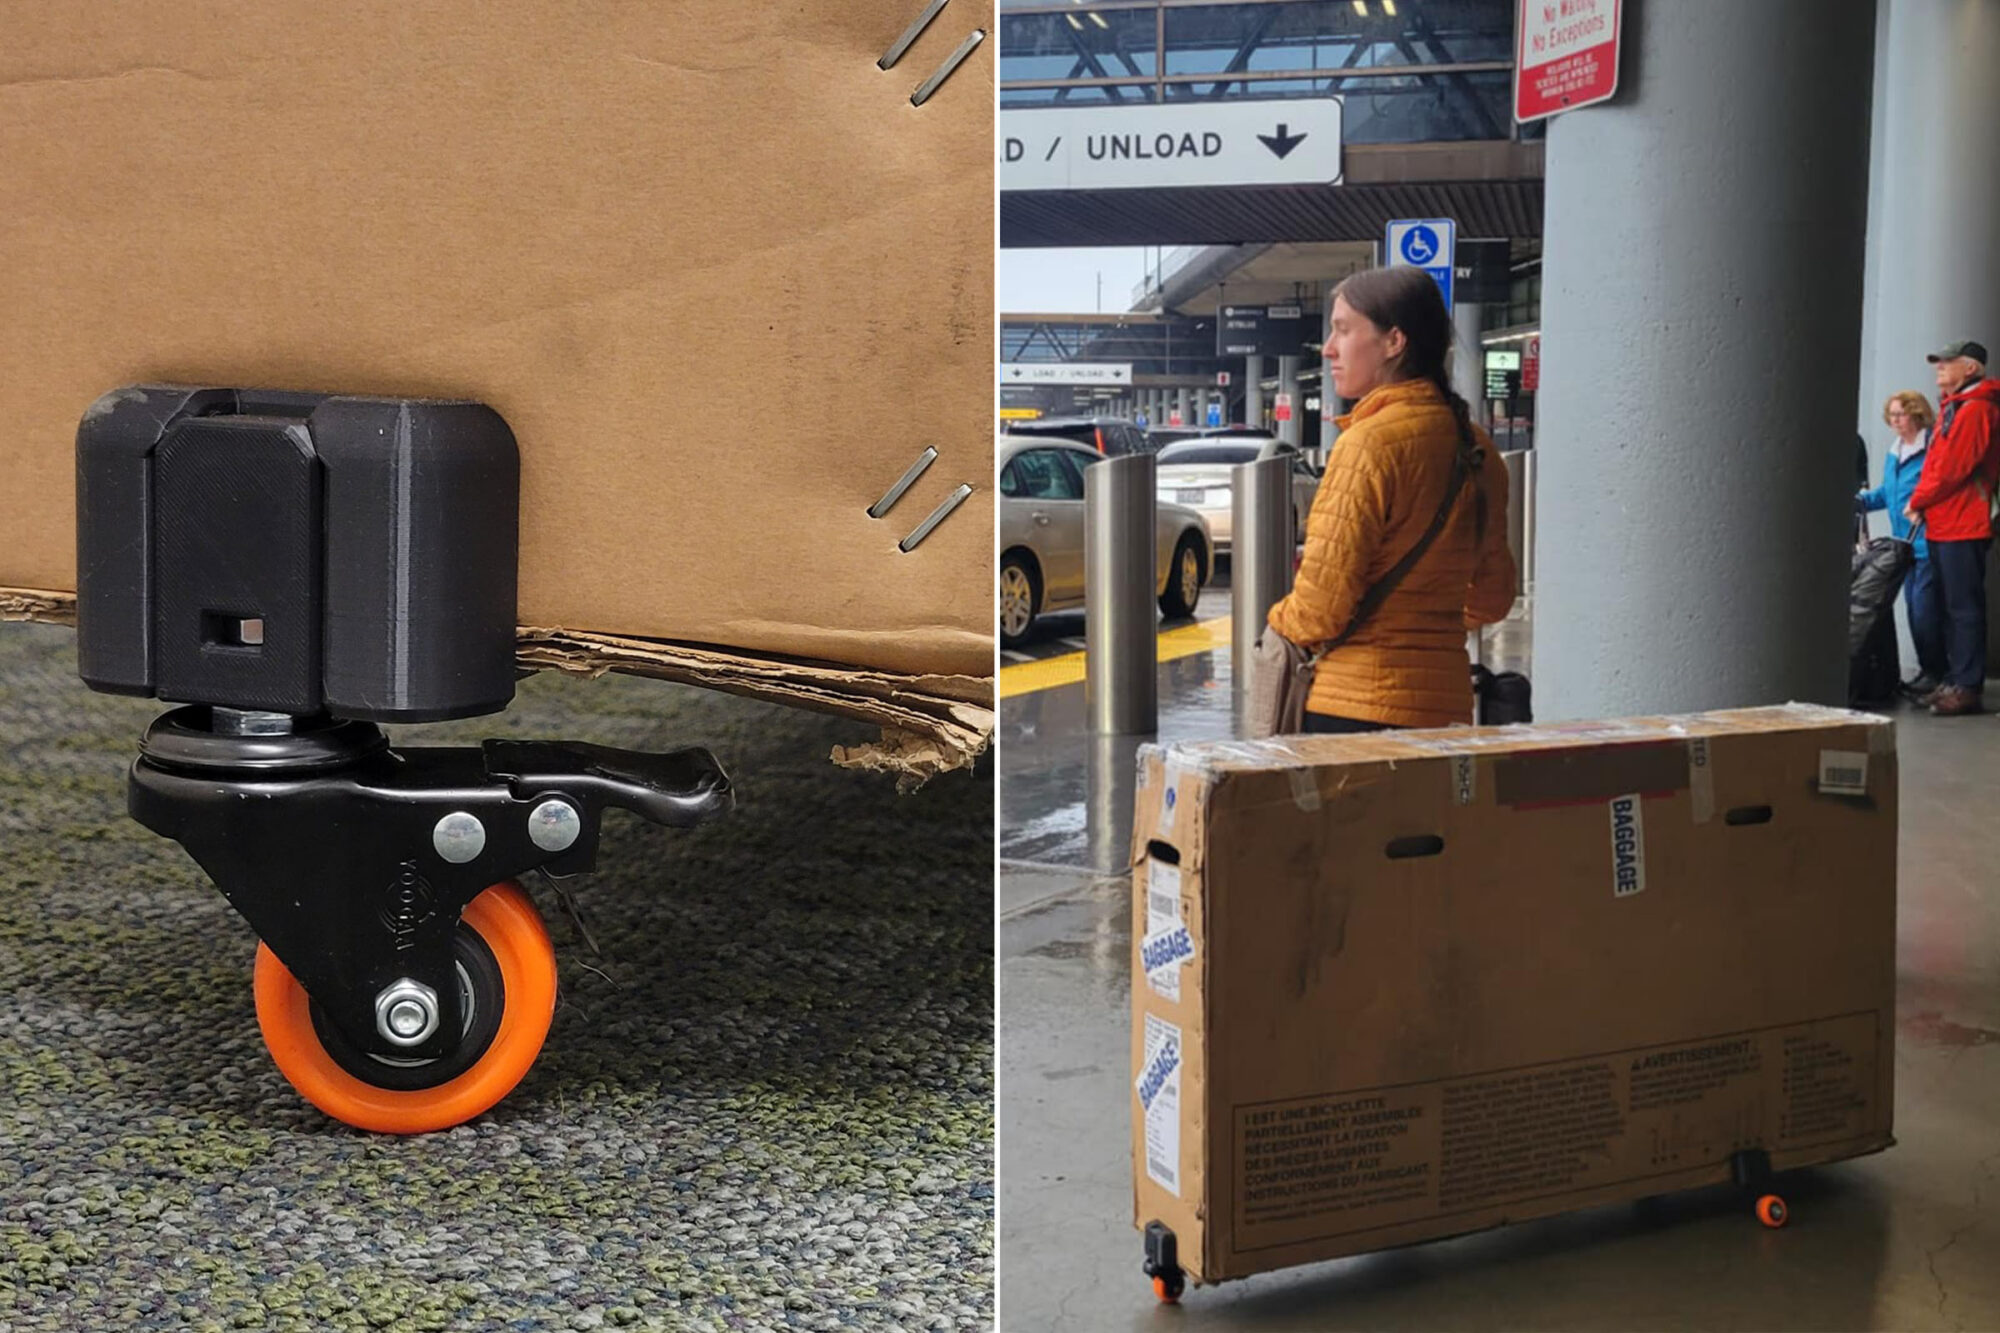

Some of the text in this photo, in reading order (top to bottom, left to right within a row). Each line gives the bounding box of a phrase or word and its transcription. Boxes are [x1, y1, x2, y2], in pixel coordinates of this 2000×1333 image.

[1532, 15, 1604, 52] No Exceptions
[1000, 138, 1024, 162] D
[1087, 132, 1222, 160] UNLOAD
[1613, 799, 1637, 894] BAGGAGE
[1143, 927, 1193, 972] BAGGAGE
[1139, 1041, 1180, 1111] BAGGAGE
[1311, 1098, 1385, 1117] BICYCLETTE
